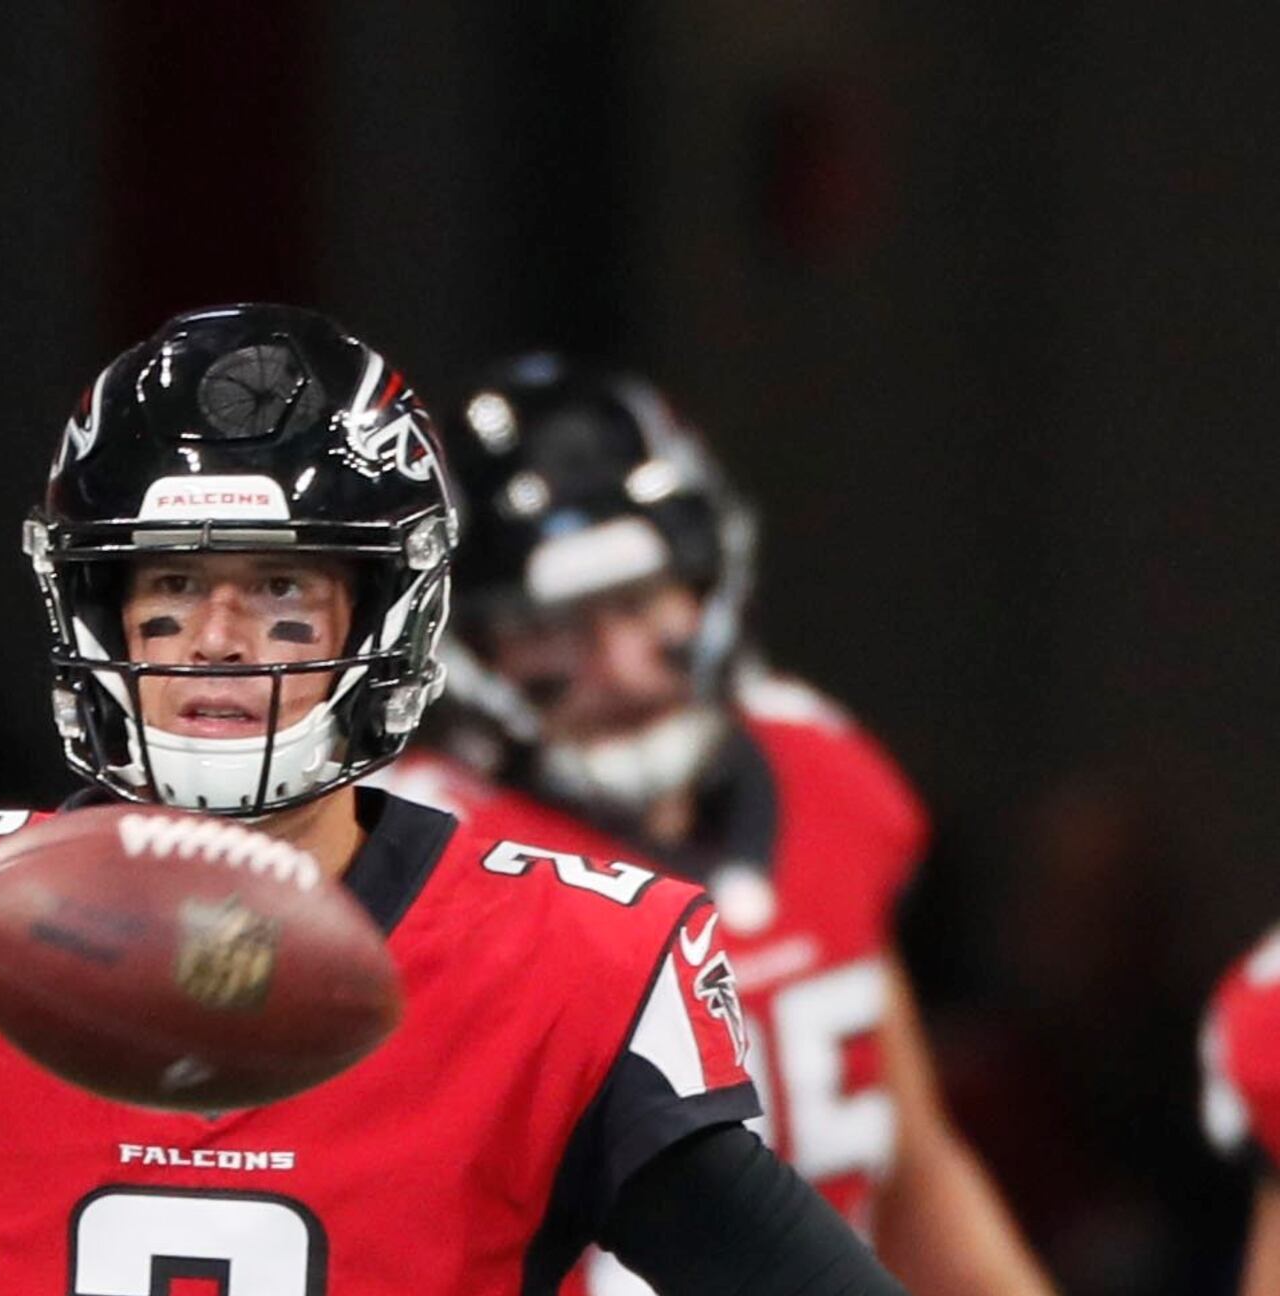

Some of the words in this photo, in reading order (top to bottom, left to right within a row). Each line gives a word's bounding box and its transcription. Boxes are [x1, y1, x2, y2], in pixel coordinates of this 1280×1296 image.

[156, 491, 272, 508] FALCONS
[480, 839, 657, 907] 2
[119, 1143, 296, 1171] FALCONS
